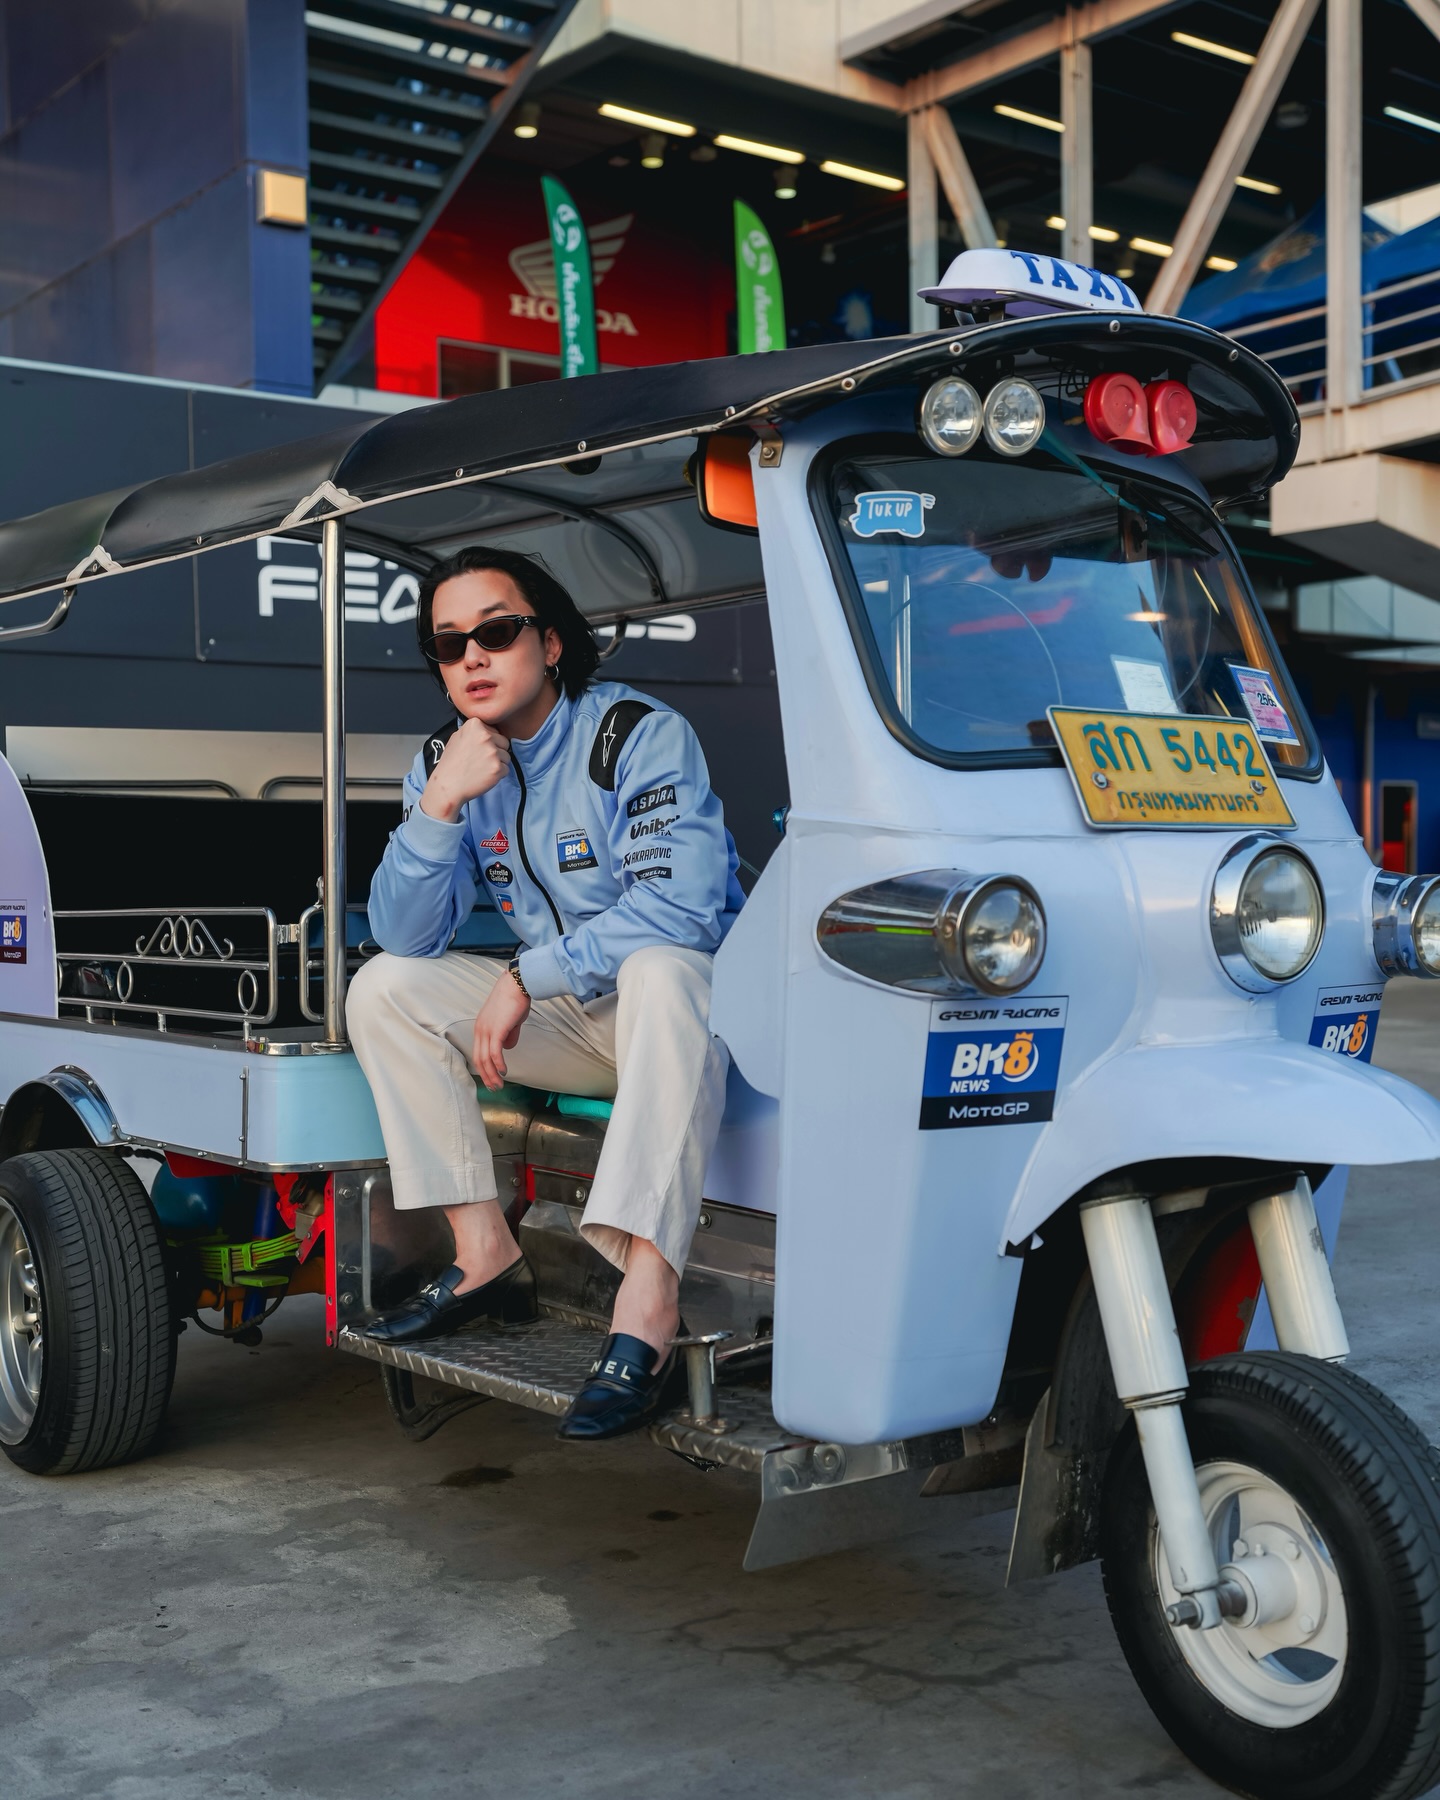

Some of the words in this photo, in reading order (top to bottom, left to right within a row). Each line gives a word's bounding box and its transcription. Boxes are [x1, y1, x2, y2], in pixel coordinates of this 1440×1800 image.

[1010, 252, 1134, 308] TAXI
[510, 295, 638, 336] HODA
[895, 502, 913, 517] UP
[1082, 721, 1152, 772] สก
[1160, 728, 1265, 777] 5442
[1117, 789, 1259, 818] กรุงเทพมหานคร
[630, 815, 680, 840] Uniba
[565, 842, 588, 856] BK8
[3, 920, 21, 939] BK8
[939, 1010, 999, 1021] GRESINI
[1002, 1008, 1060, 1019] RACING
[1322, 1020, 1367, 1053] BK8
[950, 1038, 1035, 1078] BK8
[950, 1079, 991, 1094] NEWS
